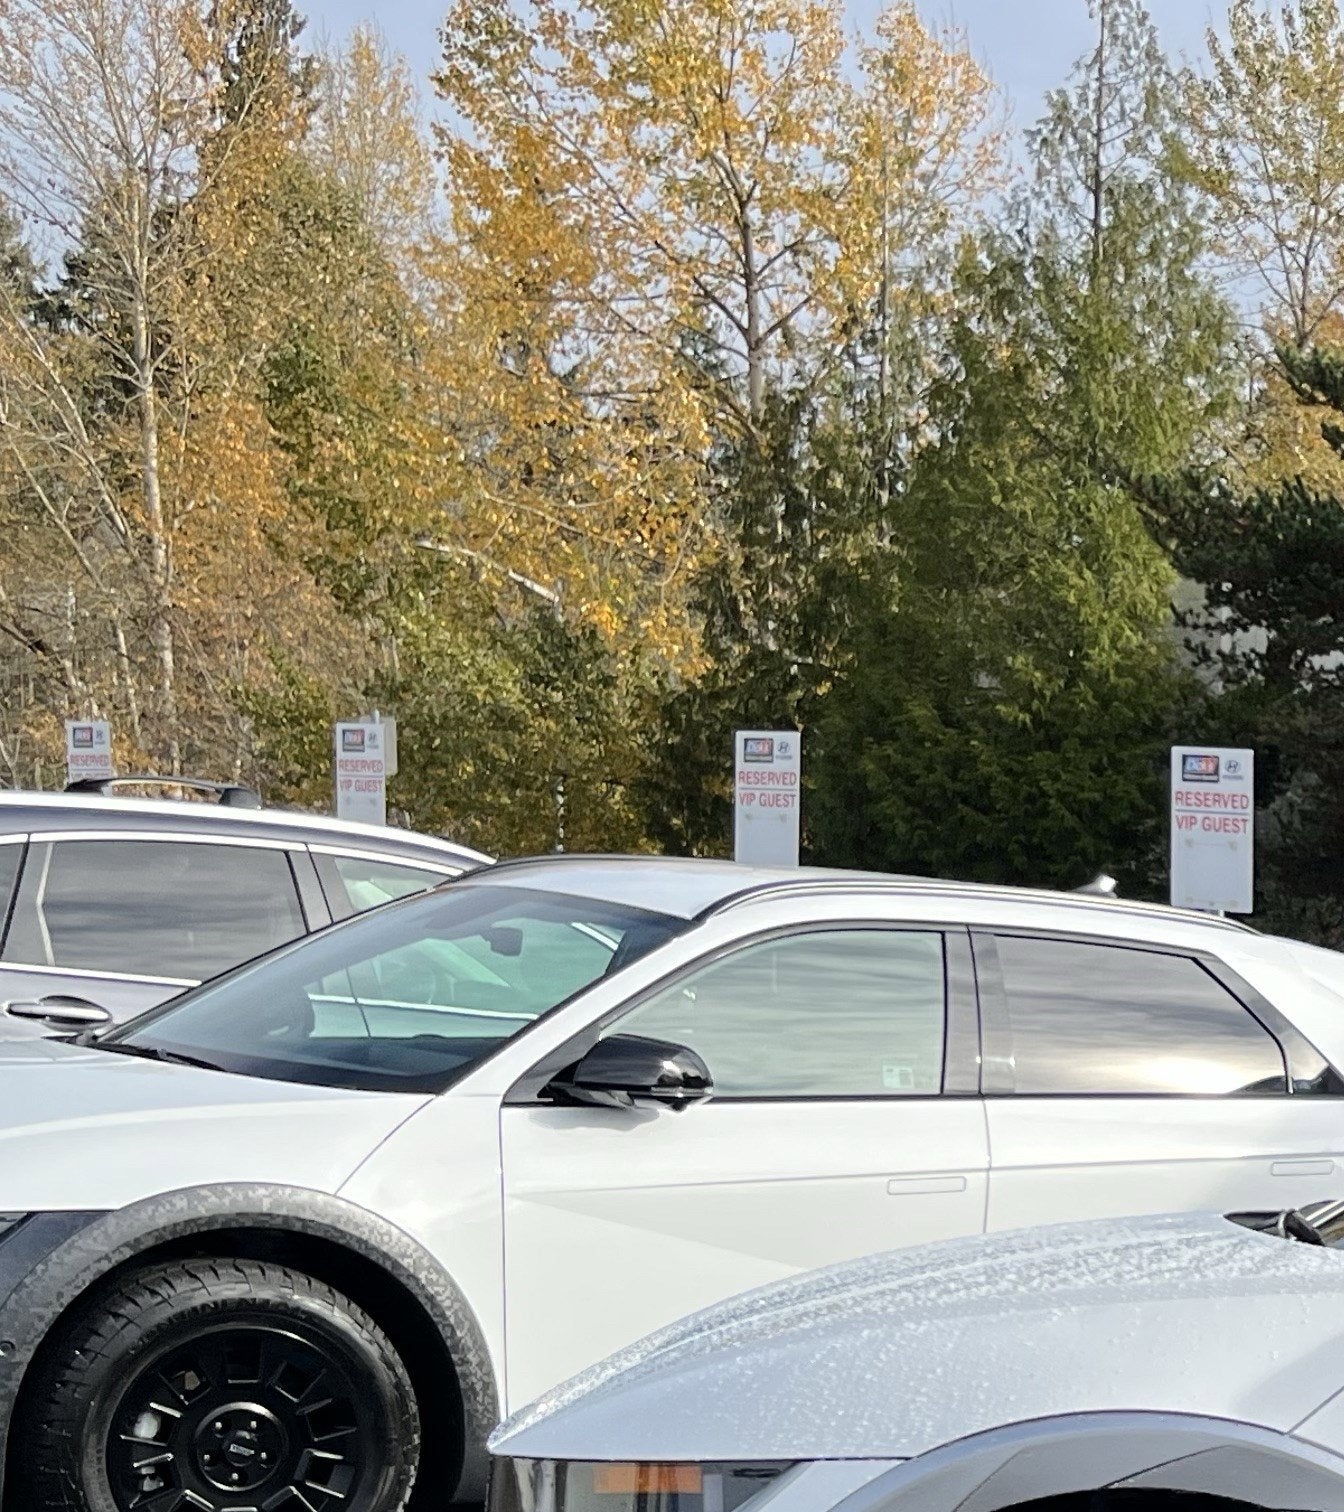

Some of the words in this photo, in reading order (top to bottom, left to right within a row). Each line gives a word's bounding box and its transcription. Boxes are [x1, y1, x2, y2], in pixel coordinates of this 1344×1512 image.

[339, 759, 384, 773] RESERVED
[355, 779, 383, 792] GUEST
[739, 771, 797, 786] RESERVED
[739, 792, 756, 806] VIP
[759, 792, 797, 808] GUEST
[1175, 791, 1250, 809] RESERVED
[1176, 815, 1198, 831] VIP
[1201, 816, 1249, 834] GUEST
